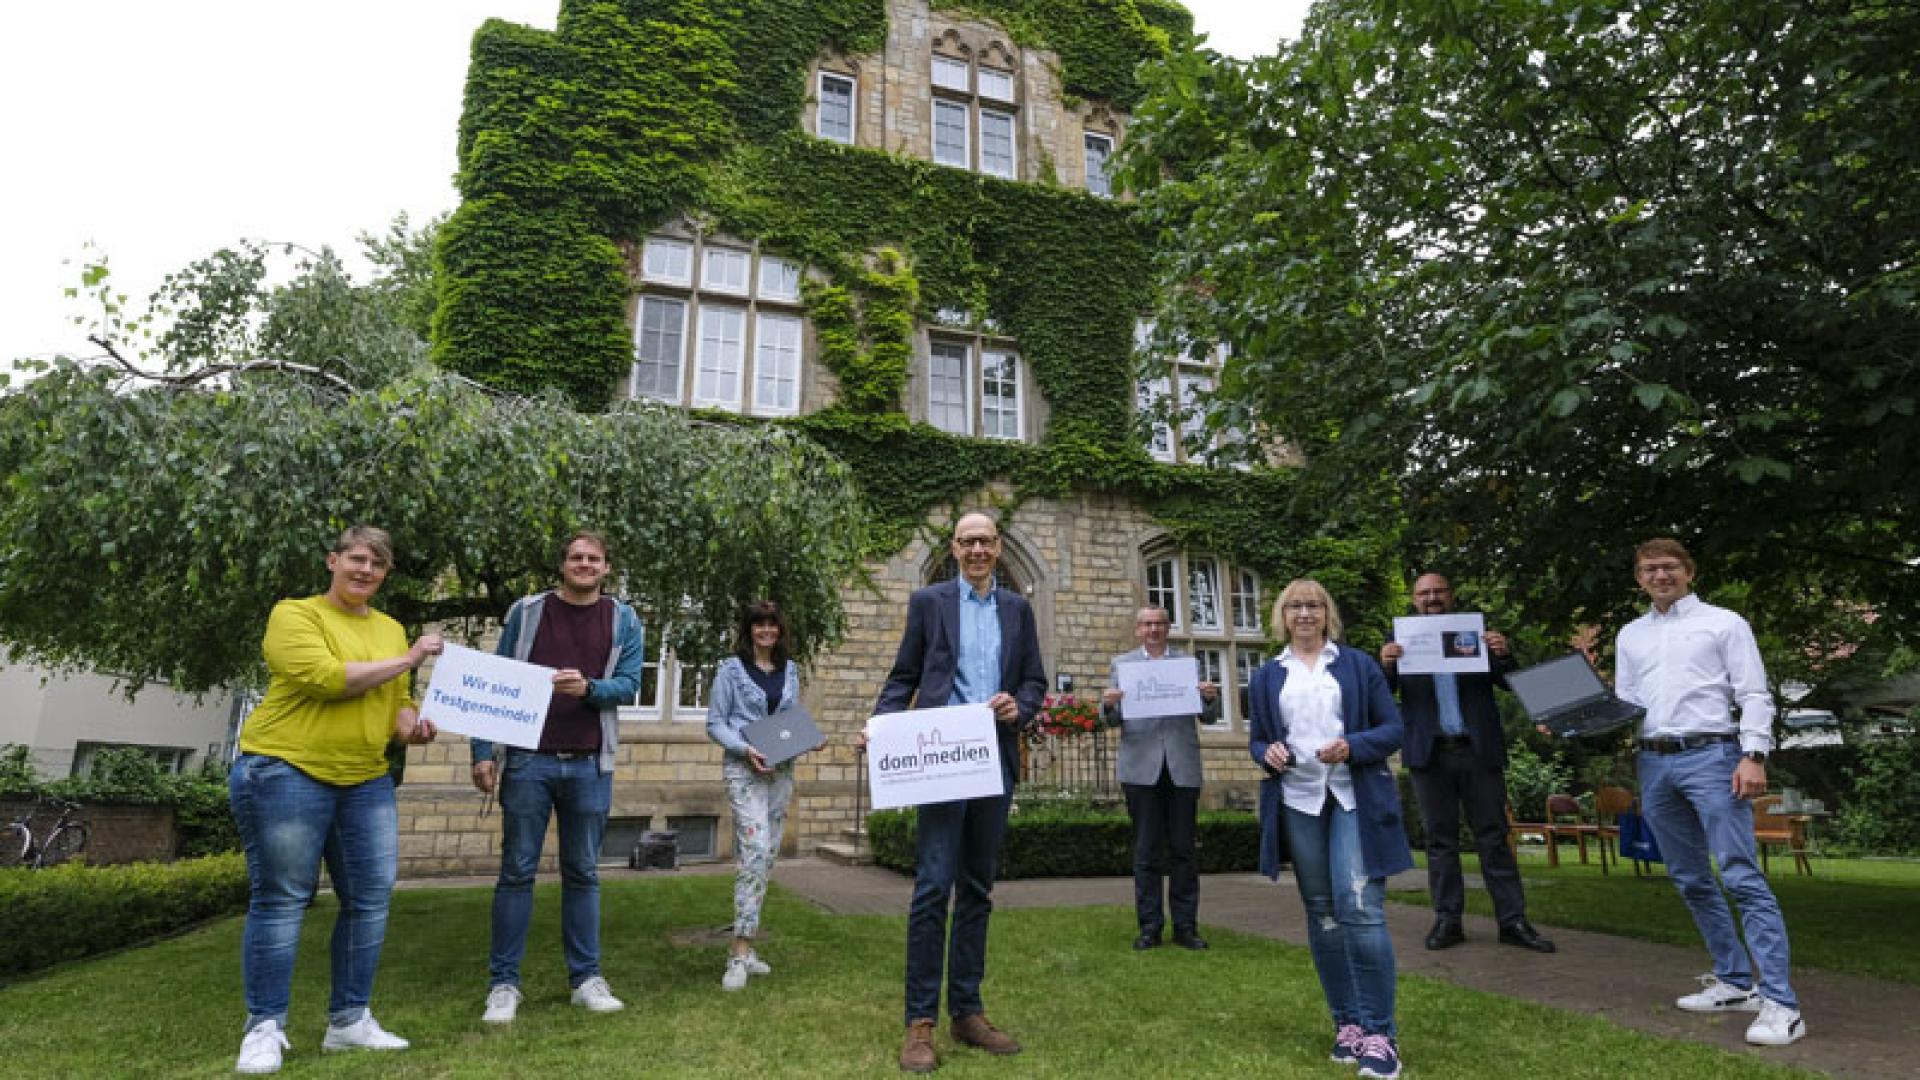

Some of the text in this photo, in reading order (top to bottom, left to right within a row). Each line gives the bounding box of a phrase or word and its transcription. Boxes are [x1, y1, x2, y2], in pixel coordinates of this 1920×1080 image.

[462, 674, 521, 699] Wir sind
[433, 688, 539, 724] Testgemeinde!
[879, 743, 990, 771] dom medien
